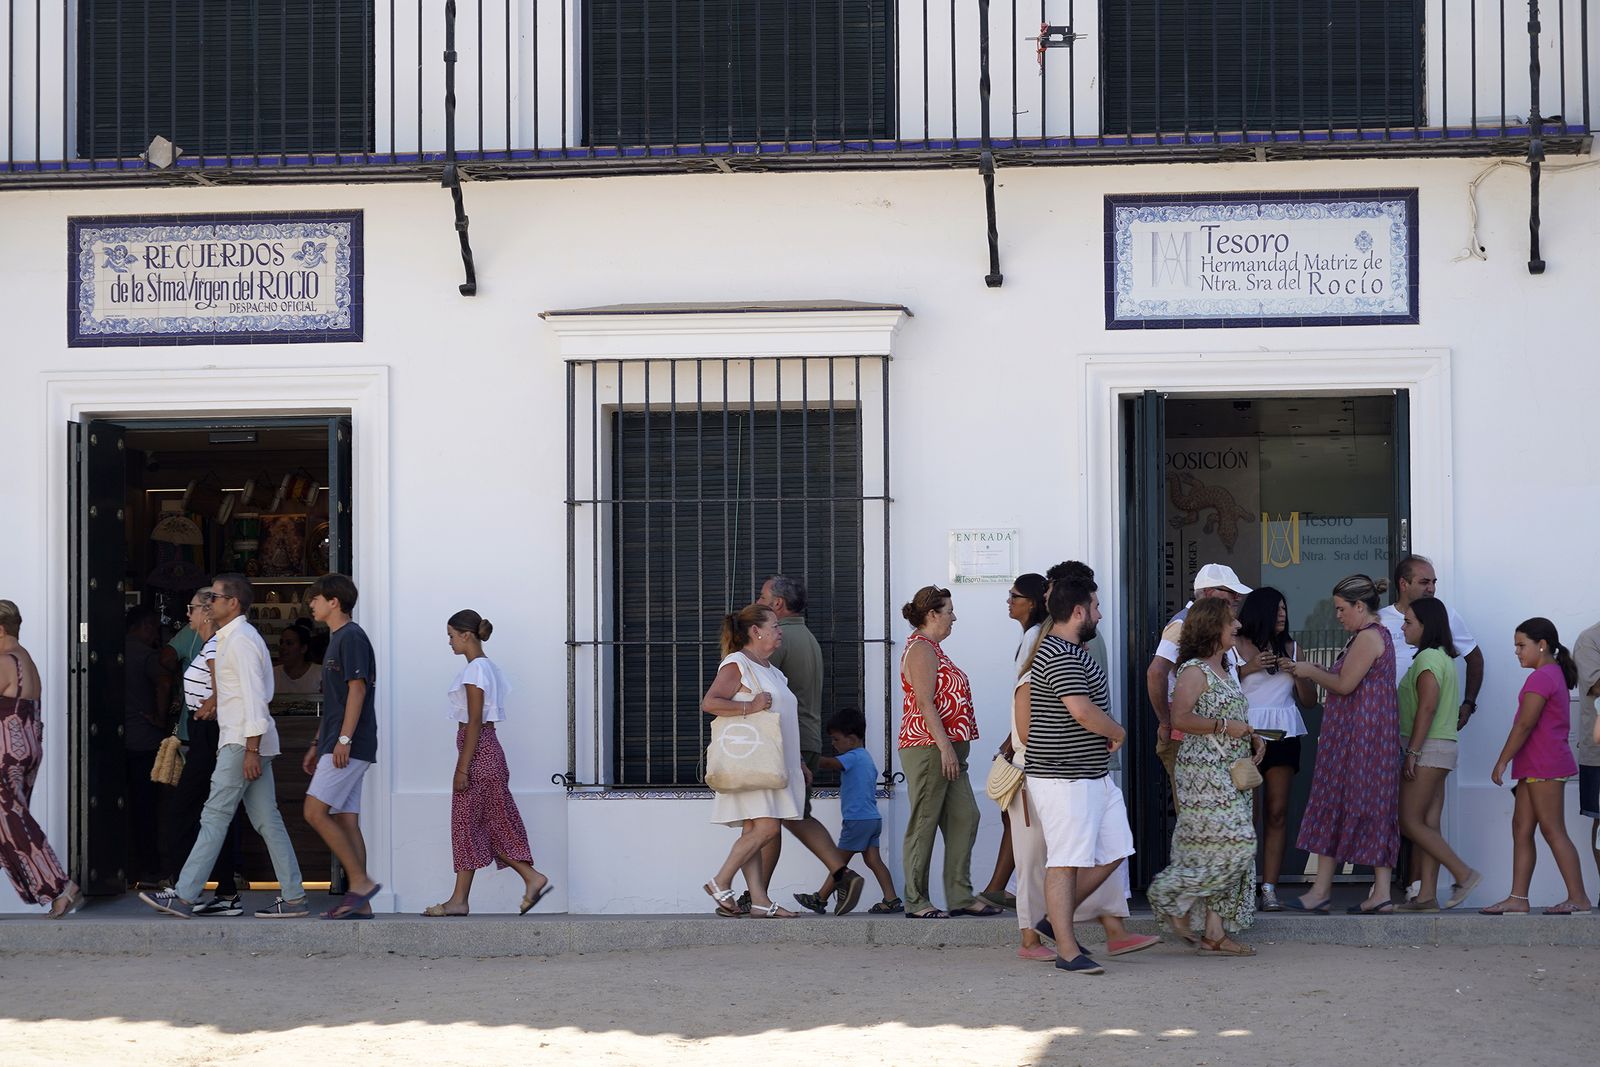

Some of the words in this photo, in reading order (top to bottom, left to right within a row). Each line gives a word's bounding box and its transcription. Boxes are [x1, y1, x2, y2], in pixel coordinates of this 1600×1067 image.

[1200, 224, 1289, 255] Tesoro
[144, 242, 285, 270] RECUERDOS
[1200, 251, 1298, 273] Hermandad
[1303, 253, 1357, 271] Matriz
[1363, 250, 1383, 270] de
[111, 274, 129, 303] de
[132, 273, 144, 303] la
[233, 270, 254, 301] del
[257, 270, 319, 300] ROCIO
[1199, 273, 1242, 292] Ntra.
[1246, 272, 1274, 291] Sra
[1277, 270, 1302, 291] del
[1307, 271, 1384, 296] Rocío
[229, 301, 278, 314] DESPACHO
[280, 300, 318, 313] OFICIAL
[1302, 511, 1353, 527] Tesoro
[956, 532, 1012, 542] ENTRADA
[1302, 534, 1359, 546] Hermandad
[1301, 551, 1327, 561] Ntra.
[1334, 550, 1350, 561] Sra
[1353, 550, 1369, 561] del
[962, 575, 981, 584] Tesoro
